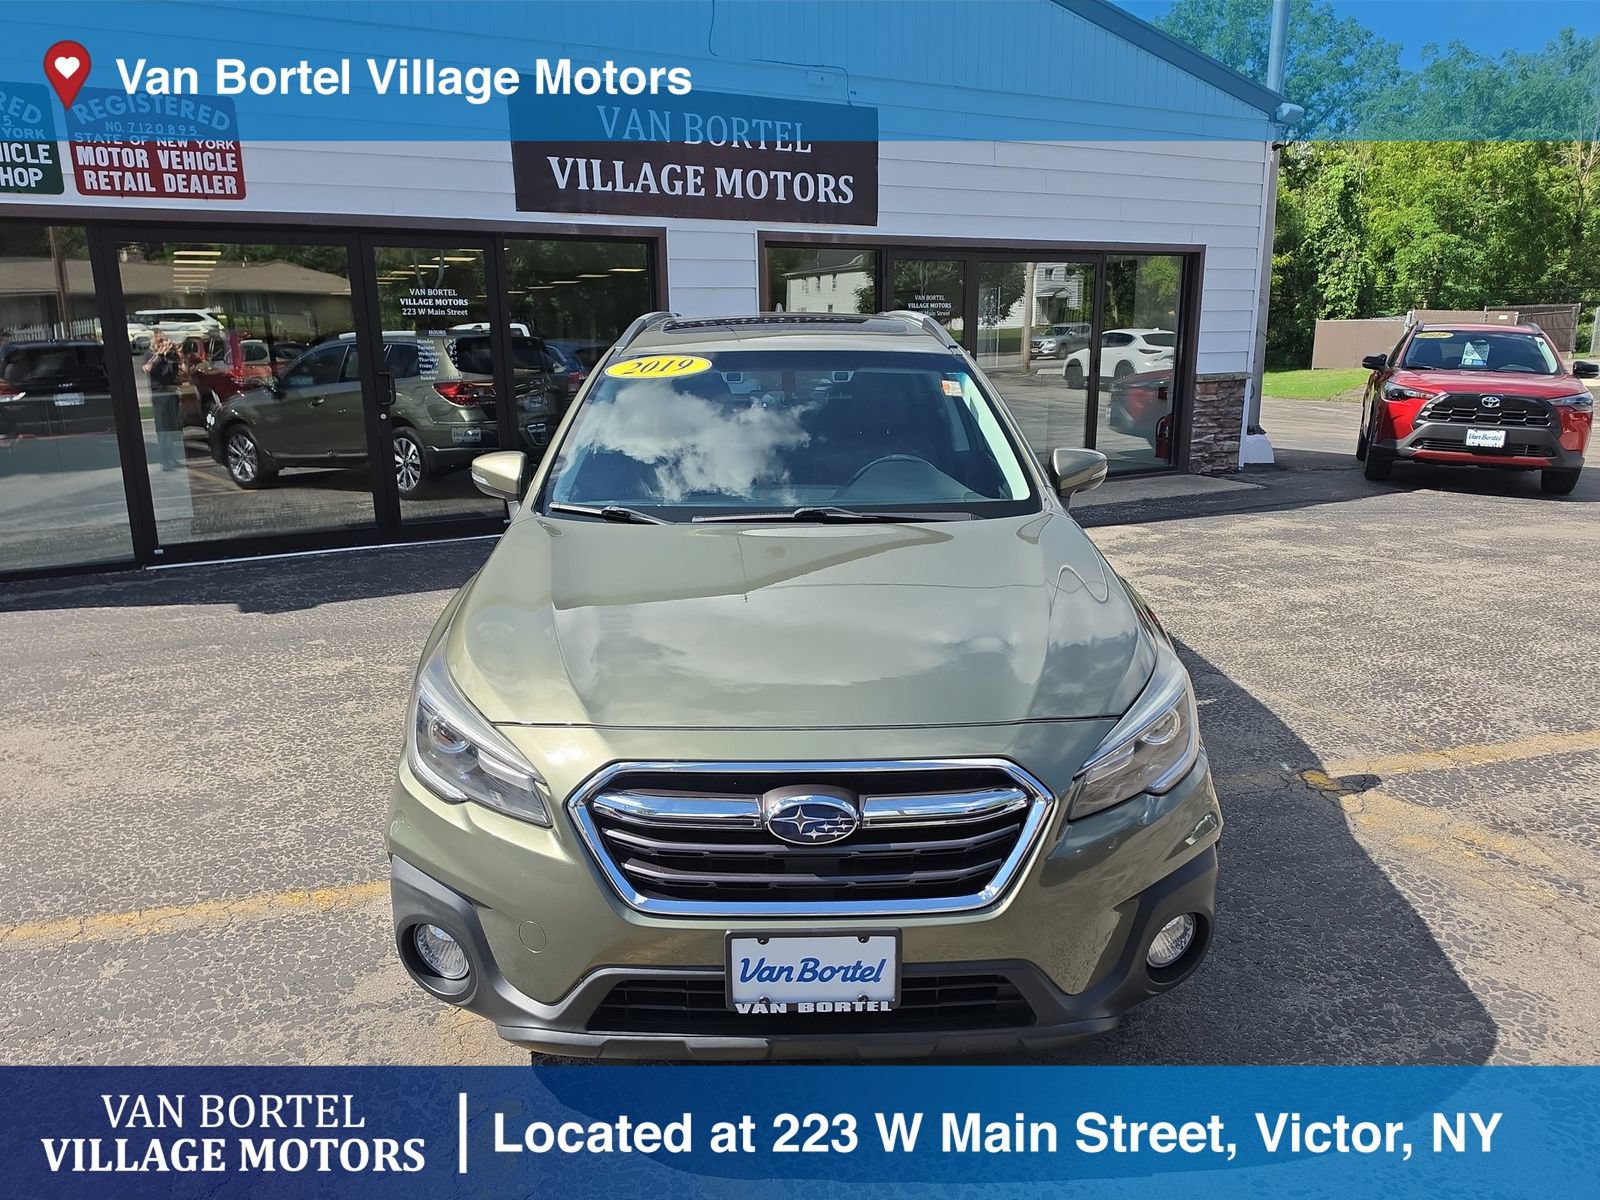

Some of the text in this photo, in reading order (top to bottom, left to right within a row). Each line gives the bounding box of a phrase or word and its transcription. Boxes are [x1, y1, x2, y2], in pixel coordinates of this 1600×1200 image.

[72, 94, 231, 131] REGISTERED
[105, 121, 125, 133] NO.
[596, 105, 812, 154] VAN BORTEL
[74, 132, 236, 150] STATE OF NEW YORK
[0, 142, 53, 164] ICLE
[76, 145, 239, 172] MOTOR VEHICLE
[83, 169, 238, 195] RETAIL DEALER
[546, 156, 854, 204] VILLAGE MOTORS
[400, 298, 469, 306] VILLAGE MOTORS
[409, 288, 458, 296] VAN BORTEL
[402, 308, 469, 316] 223 W Main Street
[621, 359, 694, 375] 2019
[739, 957, 887, 983] Van Bortel
[735, 1000, 892, 1014] VAN BORTEL
